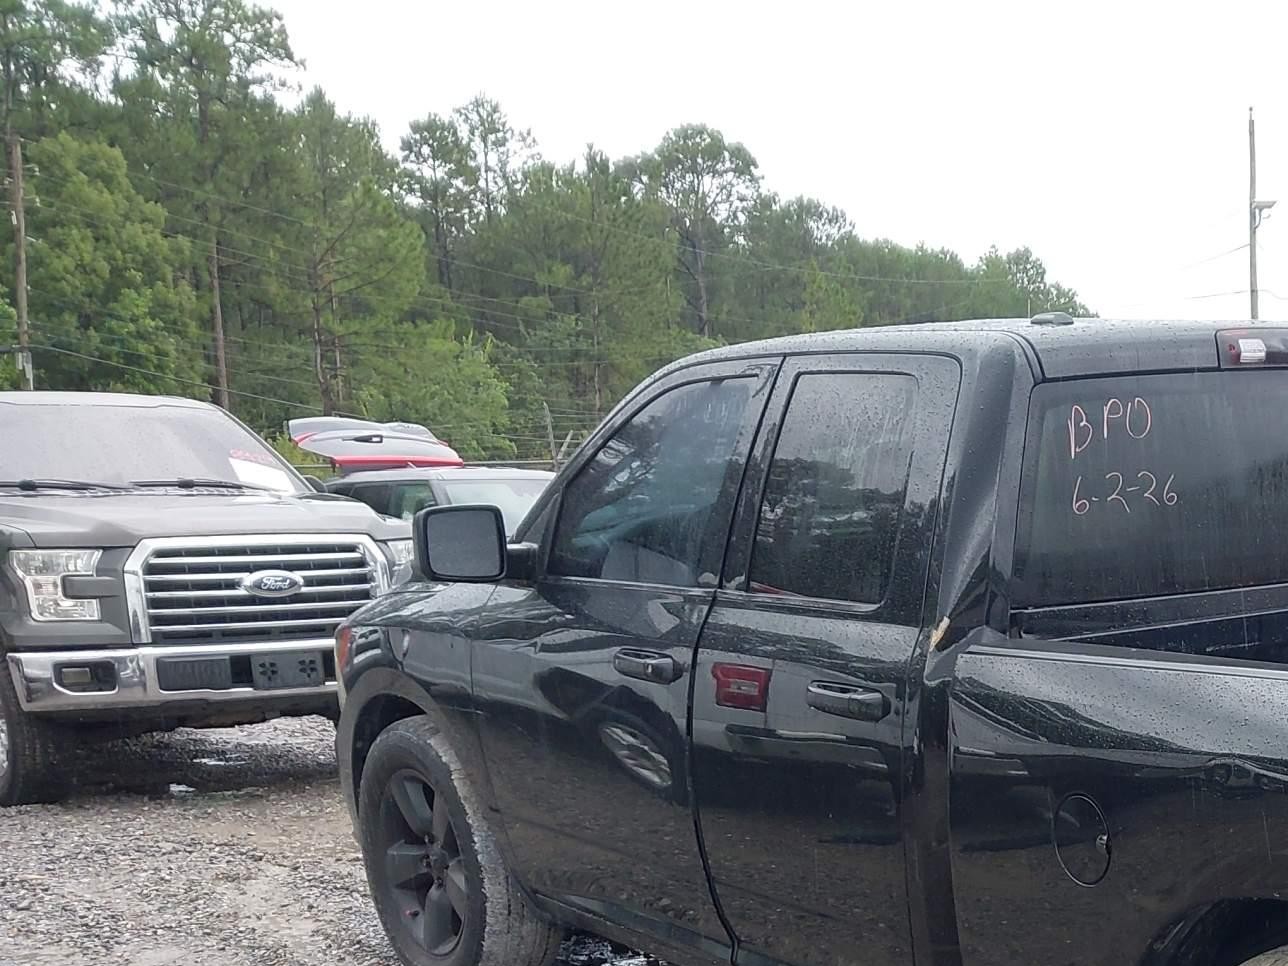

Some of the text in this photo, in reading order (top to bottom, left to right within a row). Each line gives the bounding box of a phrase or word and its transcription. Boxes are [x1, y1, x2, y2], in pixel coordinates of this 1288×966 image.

[1067, 397, 1152, 460] BPO
[1072, 470, 1178, 515] 6-2-26
[261, 576, 290, 590] Ford
